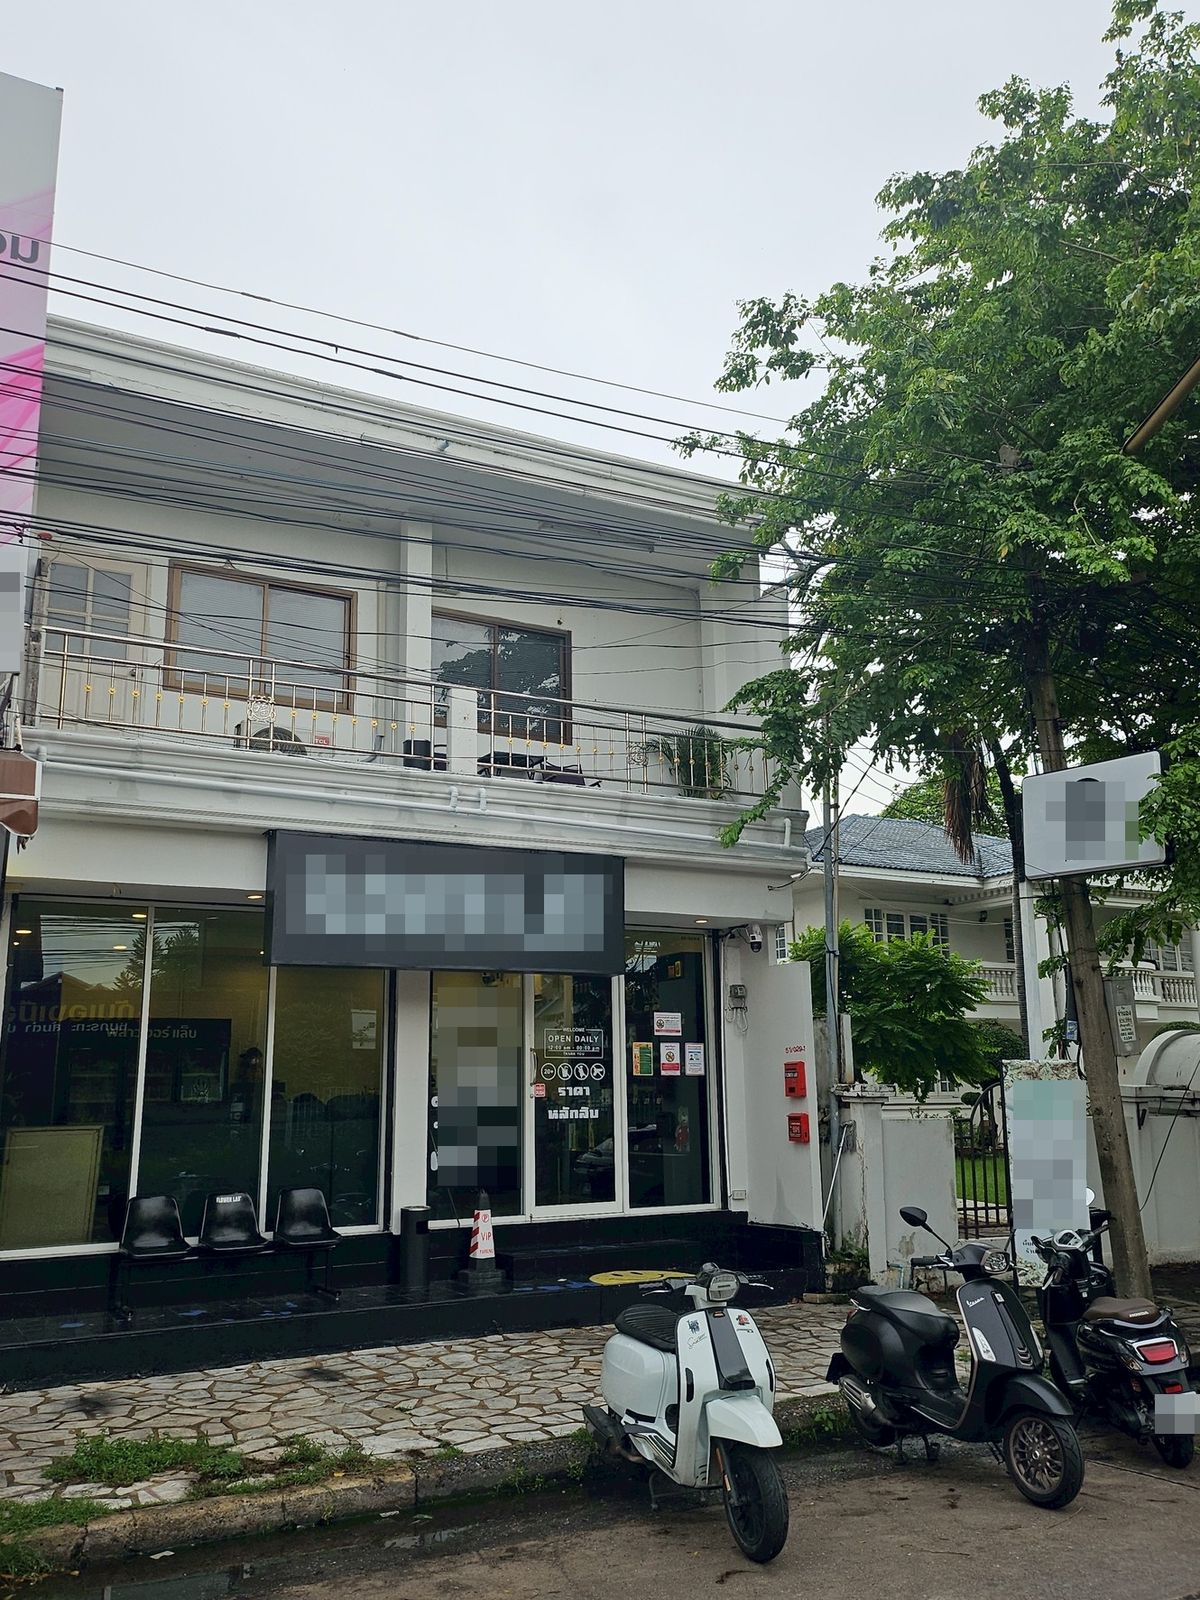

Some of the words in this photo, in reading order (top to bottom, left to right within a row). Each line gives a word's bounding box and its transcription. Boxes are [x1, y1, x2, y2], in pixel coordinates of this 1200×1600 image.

[548, 1034, 571, 1043] OPEN
[574, 1035, 599, 1043] DAILY
[557, 1086, 590, 1096] ราคา
[548, 1106, 599, 1119] หลักสิบ
[480, 1231, 492, 1241] VIP
[1129, 1310, 1150, 1318] HONDA
